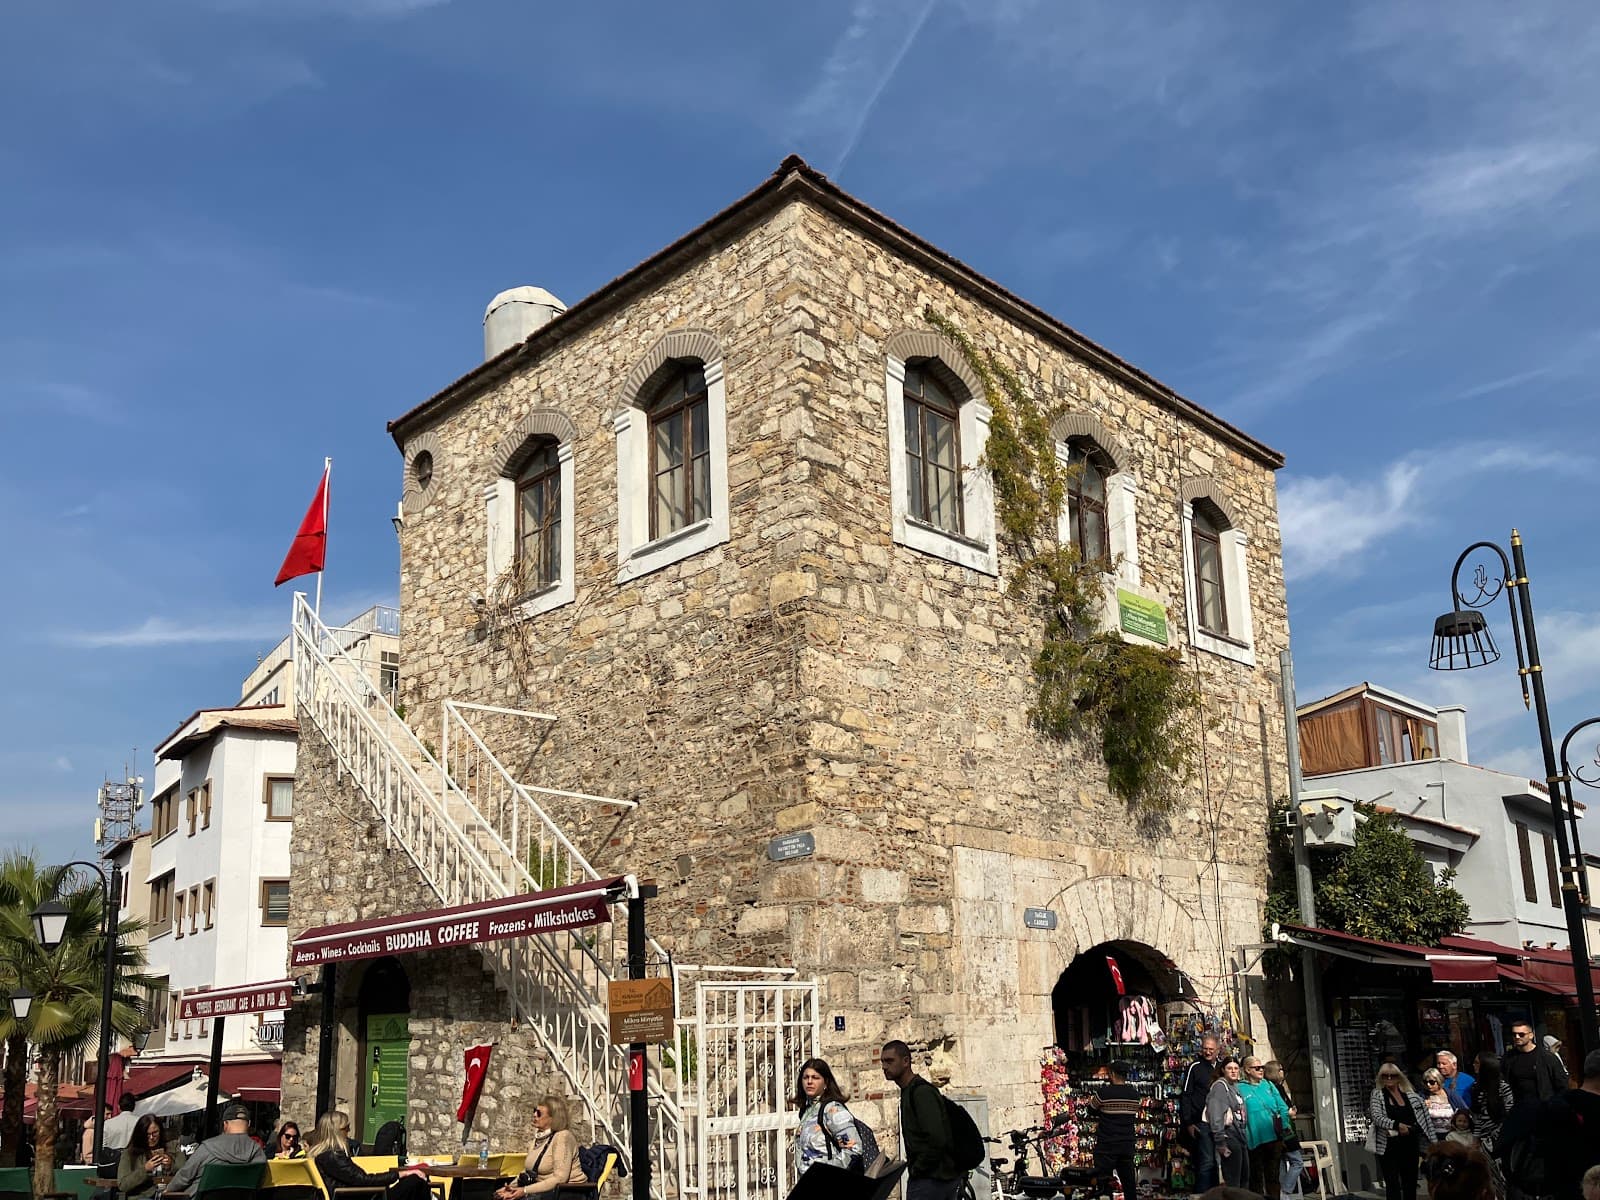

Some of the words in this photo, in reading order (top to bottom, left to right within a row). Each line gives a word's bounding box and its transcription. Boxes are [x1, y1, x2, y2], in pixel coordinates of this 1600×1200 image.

[295, 951, 315, 962] Beers
[320, 947, 342, 959] Wines
[348, 940, 381, 956] Cocktails
[385, 929, 432, 951] BUDDHA
[437, 921, 479, 944] COFFEE
[488, 919, 526, 936] Frozens
[533, 906, 596, 929] Milkshakes
[259, 1024, 271, 1041] OLD
